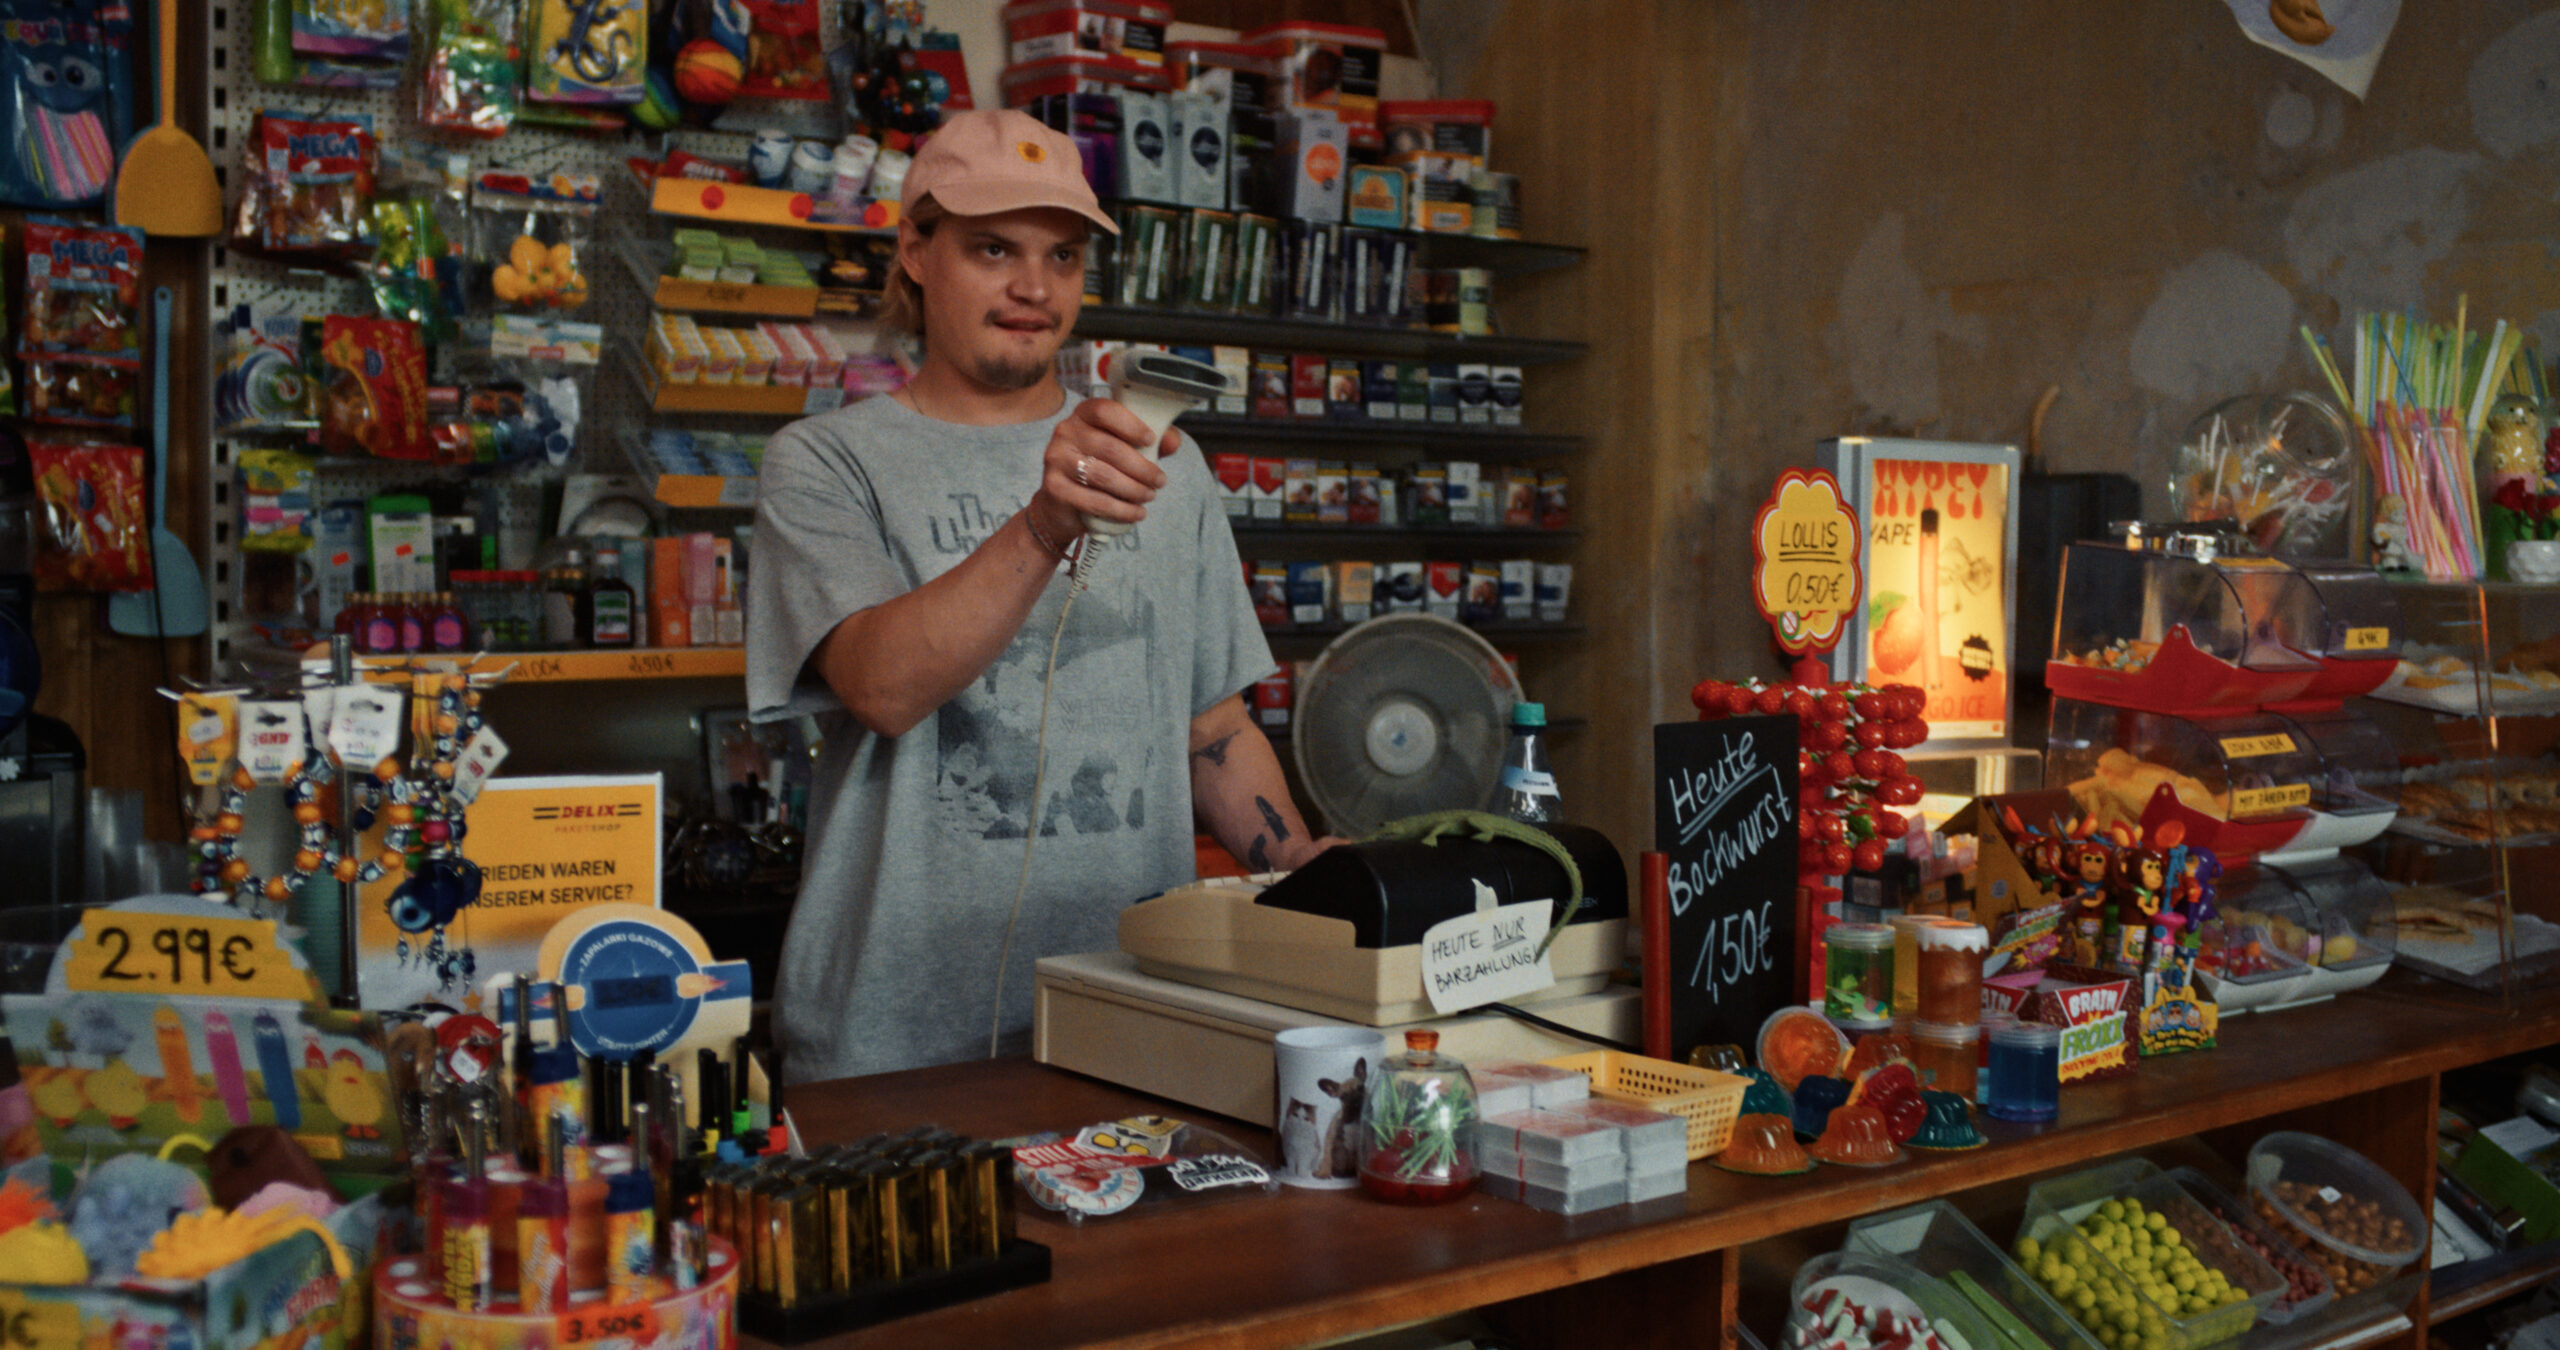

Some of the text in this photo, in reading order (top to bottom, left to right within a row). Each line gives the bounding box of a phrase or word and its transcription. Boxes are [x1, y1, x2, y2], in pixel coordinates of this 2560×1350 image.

[289, 133, 360, 160] MEGA
[51, 239, 128, 268] MEGA
[1780, 521, 1838, 549] LOLLIS
[1786, 571, 1845, 605] 0,50€
[1927, 696, 1954, 718] GO
[1669, 731, 1757, 825] Heute
[561, 804, 617, 818] DELIX
[554, 823, 622, 833] PAKETSHOP
[1668, 766, 1792, 918] Bockwurst
[480, 860, 617, 881] RIEDEN WAREN
[474, 884, 634, 909] NSEREM SERVICE?
[1431, 915, 1526, 963] HEUTE NUR
[1690, 900, 1773, 1005] 1,50€
[96, 926, 256, 984] 2.99€
[1981, 987, 2012, 1012] AIN
[2068, 988, 2118, 1018] BRAIN
[2061, 1015, 2125, 1060] FROXX
[1015, 1144, 1079, 1166] STILL
[566, 1312, 646, 1344] 3.50€
